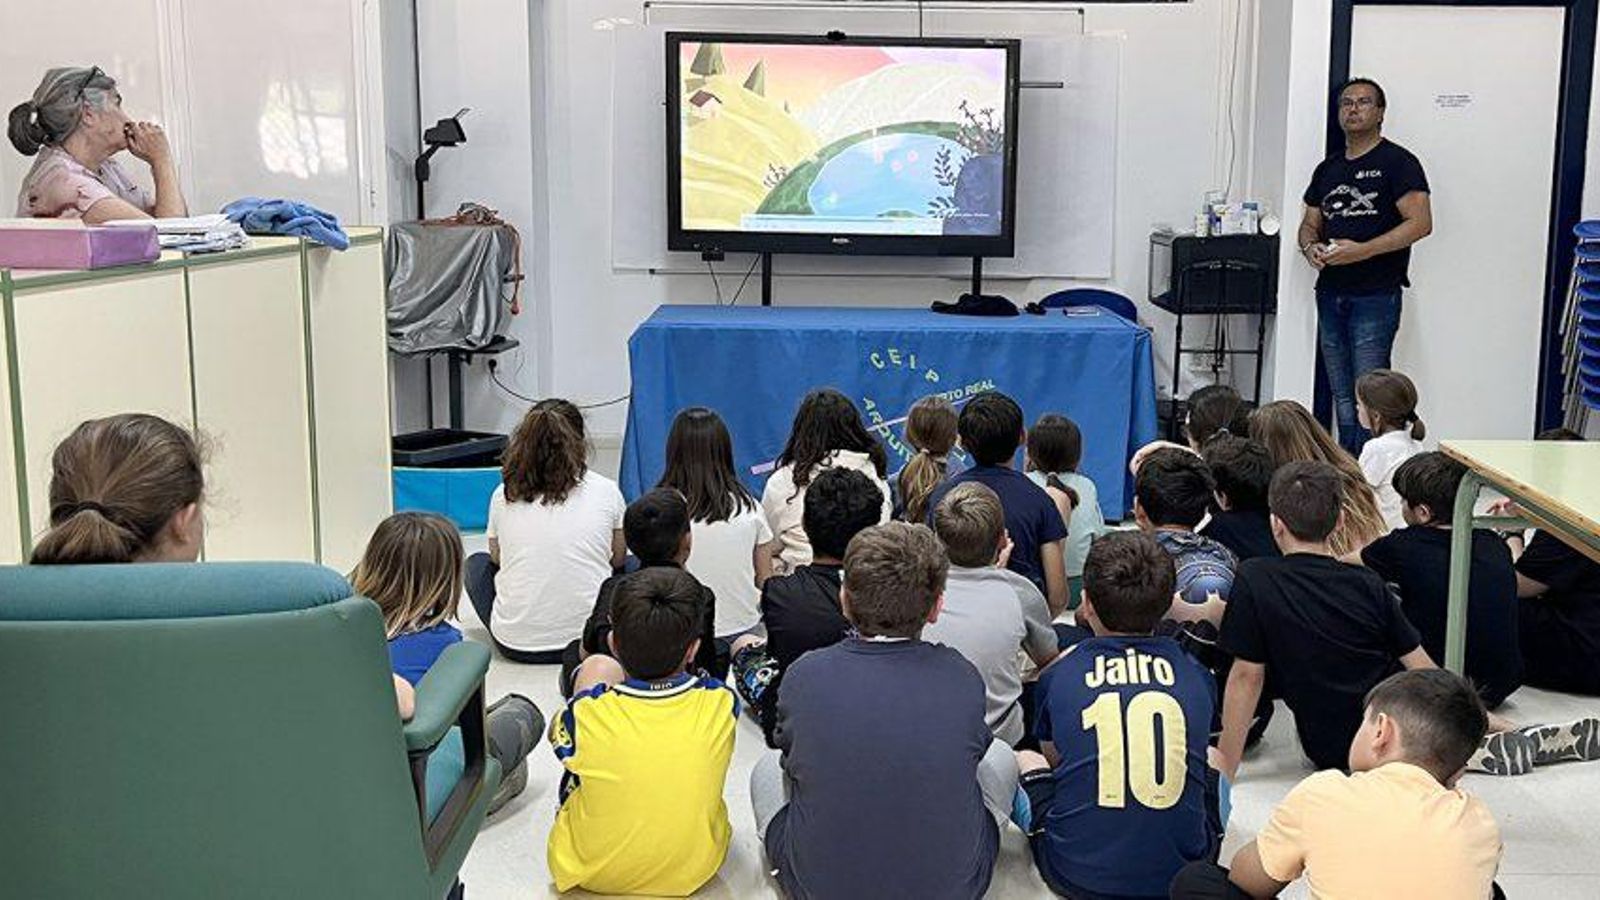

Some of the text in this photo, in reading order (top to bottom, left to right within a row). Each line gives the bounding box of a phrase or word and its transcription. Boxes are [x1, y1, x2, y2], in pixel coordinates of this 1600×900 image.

[965, 379, 996, 396] REAL
[863, 397, 914, 462] ARQUIT
[1085, 648, 1175, 688] Jairo
[1081, 690, 1188, 810] 10
